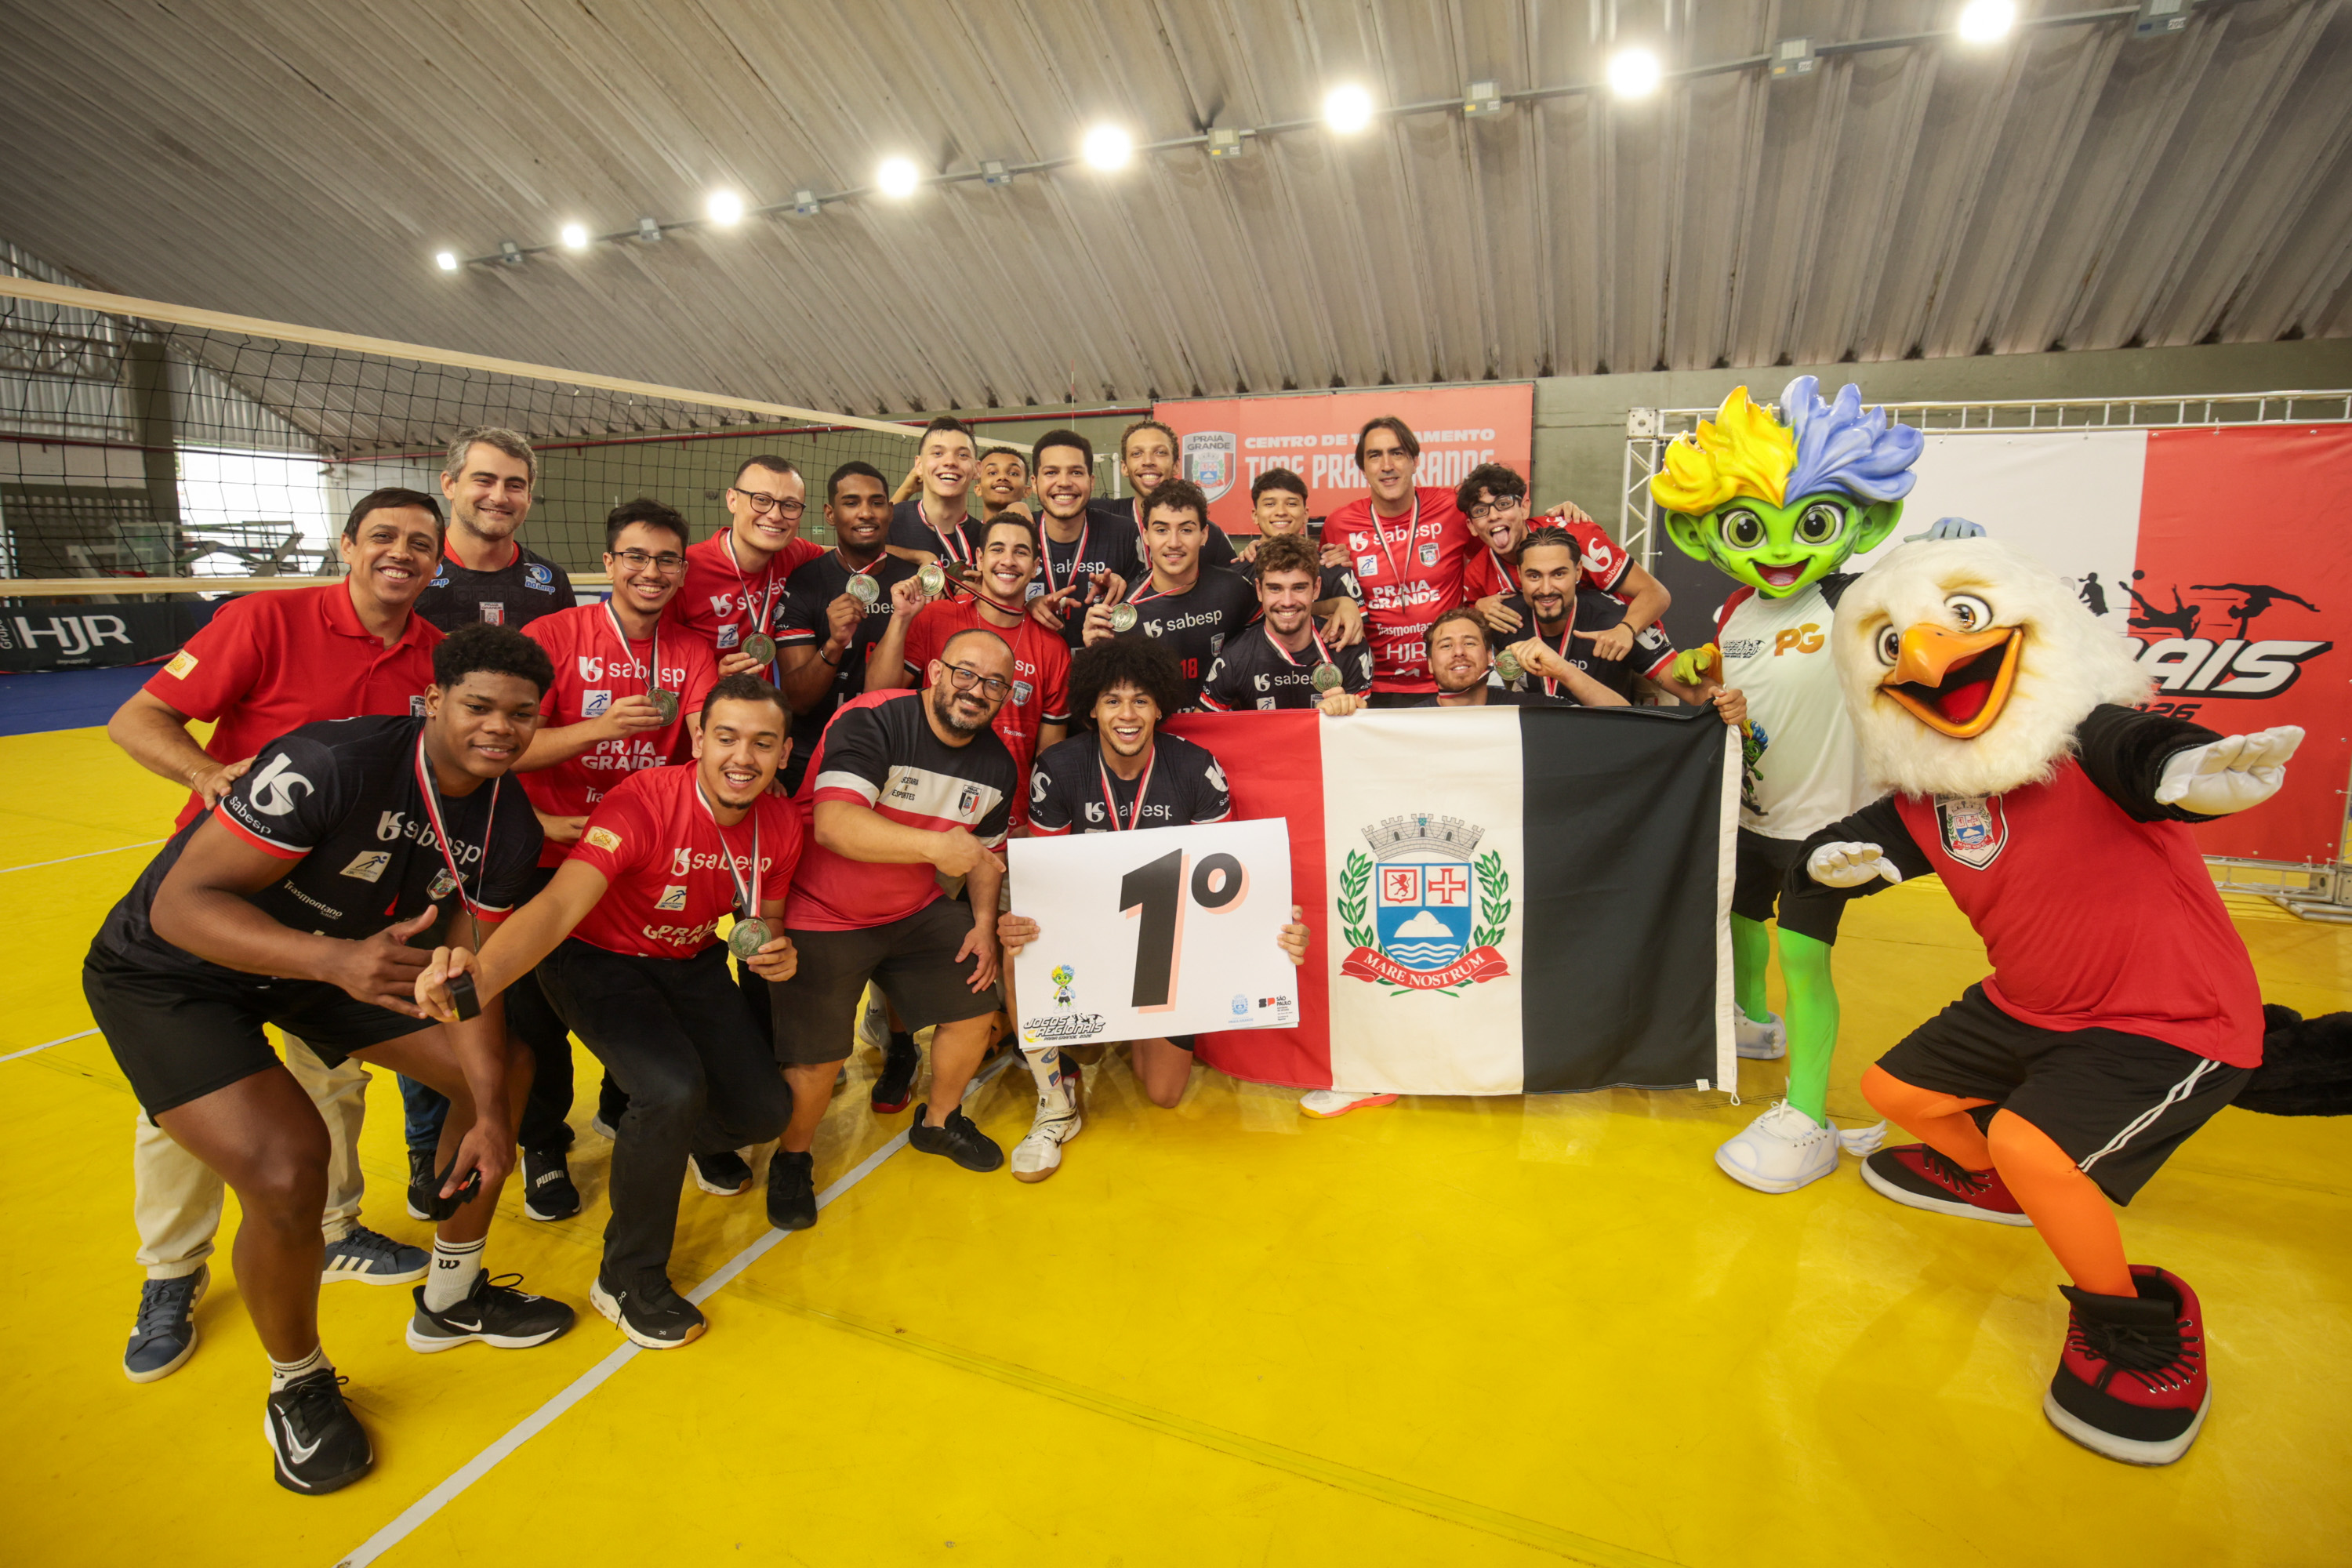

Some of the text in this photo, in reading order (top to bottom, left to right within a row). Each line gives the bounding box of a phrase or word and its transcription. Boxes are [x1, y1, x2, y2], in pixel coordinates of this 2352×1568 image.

[1245, 435, 1317, 448] CENTRO
[1321, 434, 1348, 446] DE
[1312, 453, 1370, 488] PRA
[1604, 557, 1623, 583] sabesp
[1368, 590, 1441, 610] GRANDE
[1372, 579, 1431, 598] PRAIA
[1167, 609, 1222, 632] sabesp
[1376, 622, 1433, 637] Trasmontan
[14, 615, 133, 655] HJR
[1774, 622, 1825, 656] PG
[1386, 641, 1427, 663] HJR
[609, 659, 686, 688] sabsp
[1179, 657, 1198, 680] 18
[230, 796, 271, 835] sabesp
[284, 879, 343, 917] Trasmontano
[1363, 952, 1486, 986] MARE NOSTRUM
[1023, 1015, 1070, 1029] JOGOS
[1036, 1022, 1105, 1037] REGIONAIS
[535, 1170, 564, 1188] PUMA
